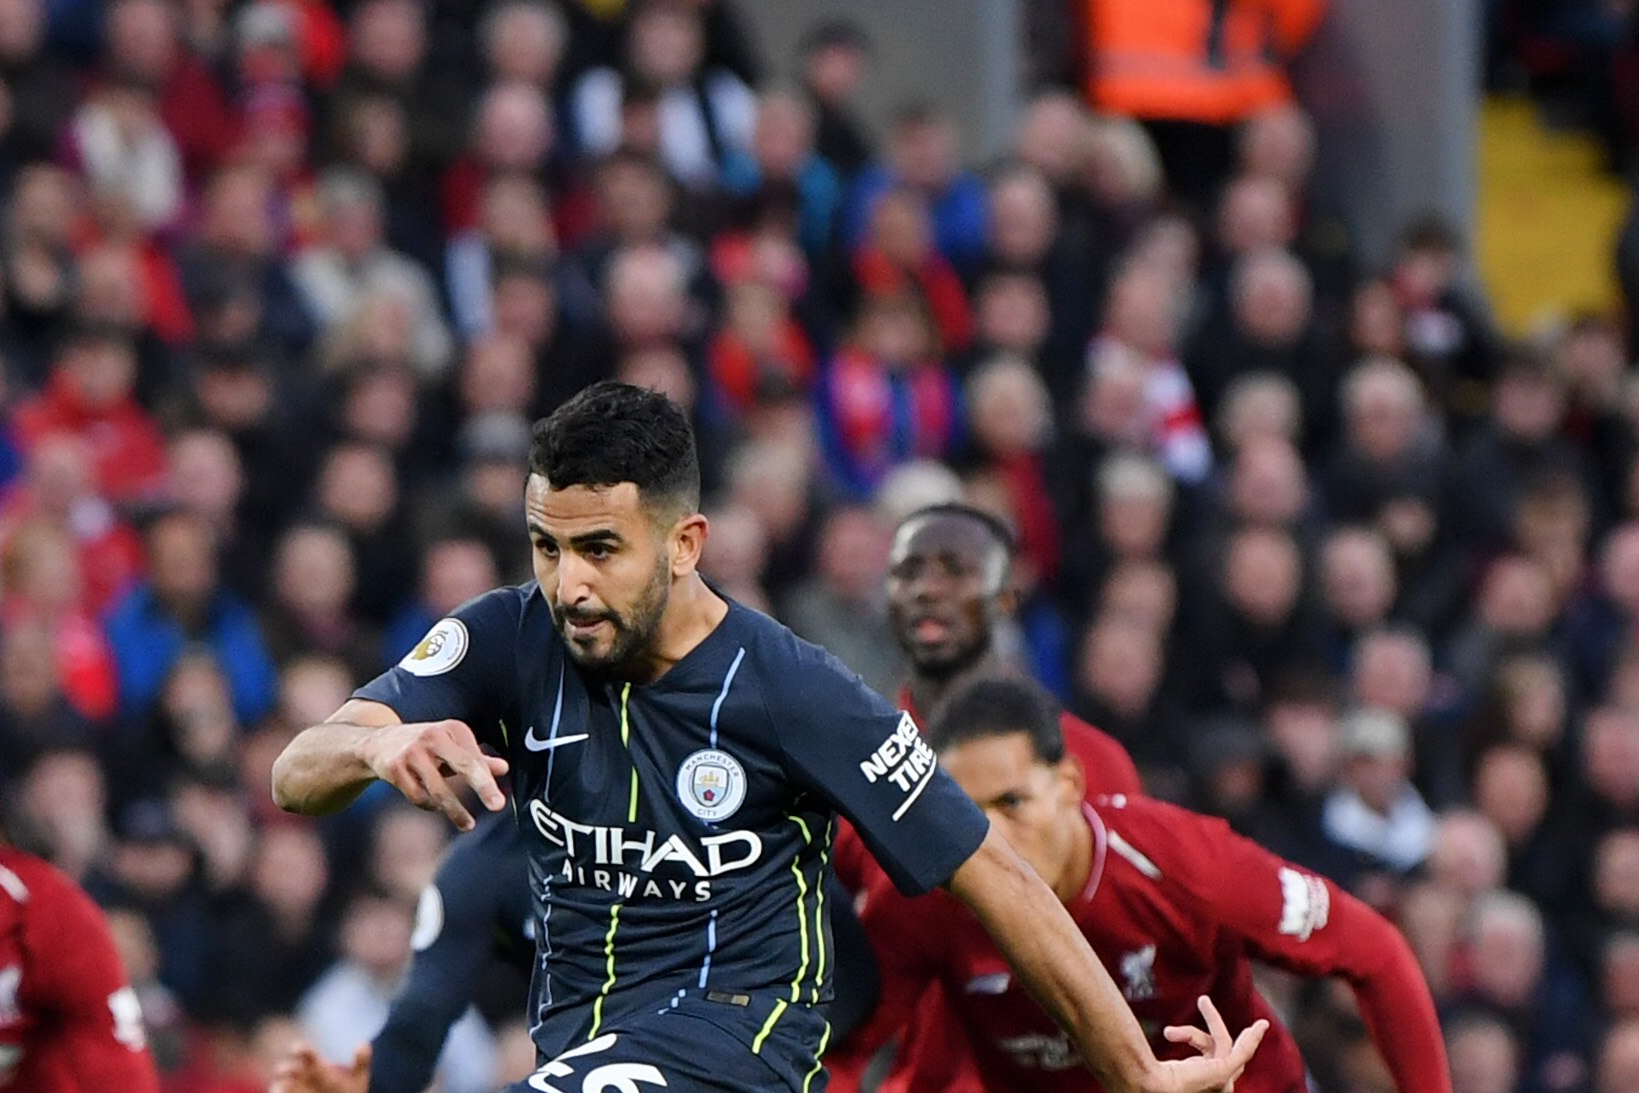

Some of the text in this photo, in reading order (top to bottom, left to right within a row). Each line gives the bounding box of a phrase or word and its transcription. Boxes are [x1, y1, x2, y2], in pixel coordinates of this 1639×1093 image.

[686, 753, 740, 777] MANCHESTER
[860, 709, 919, 783] NEXE
[697, 808, 717, 817] CITY
[530, 799, 762, 876] ETIHAD
[562, 858, 711, 902] AIRWAYS
